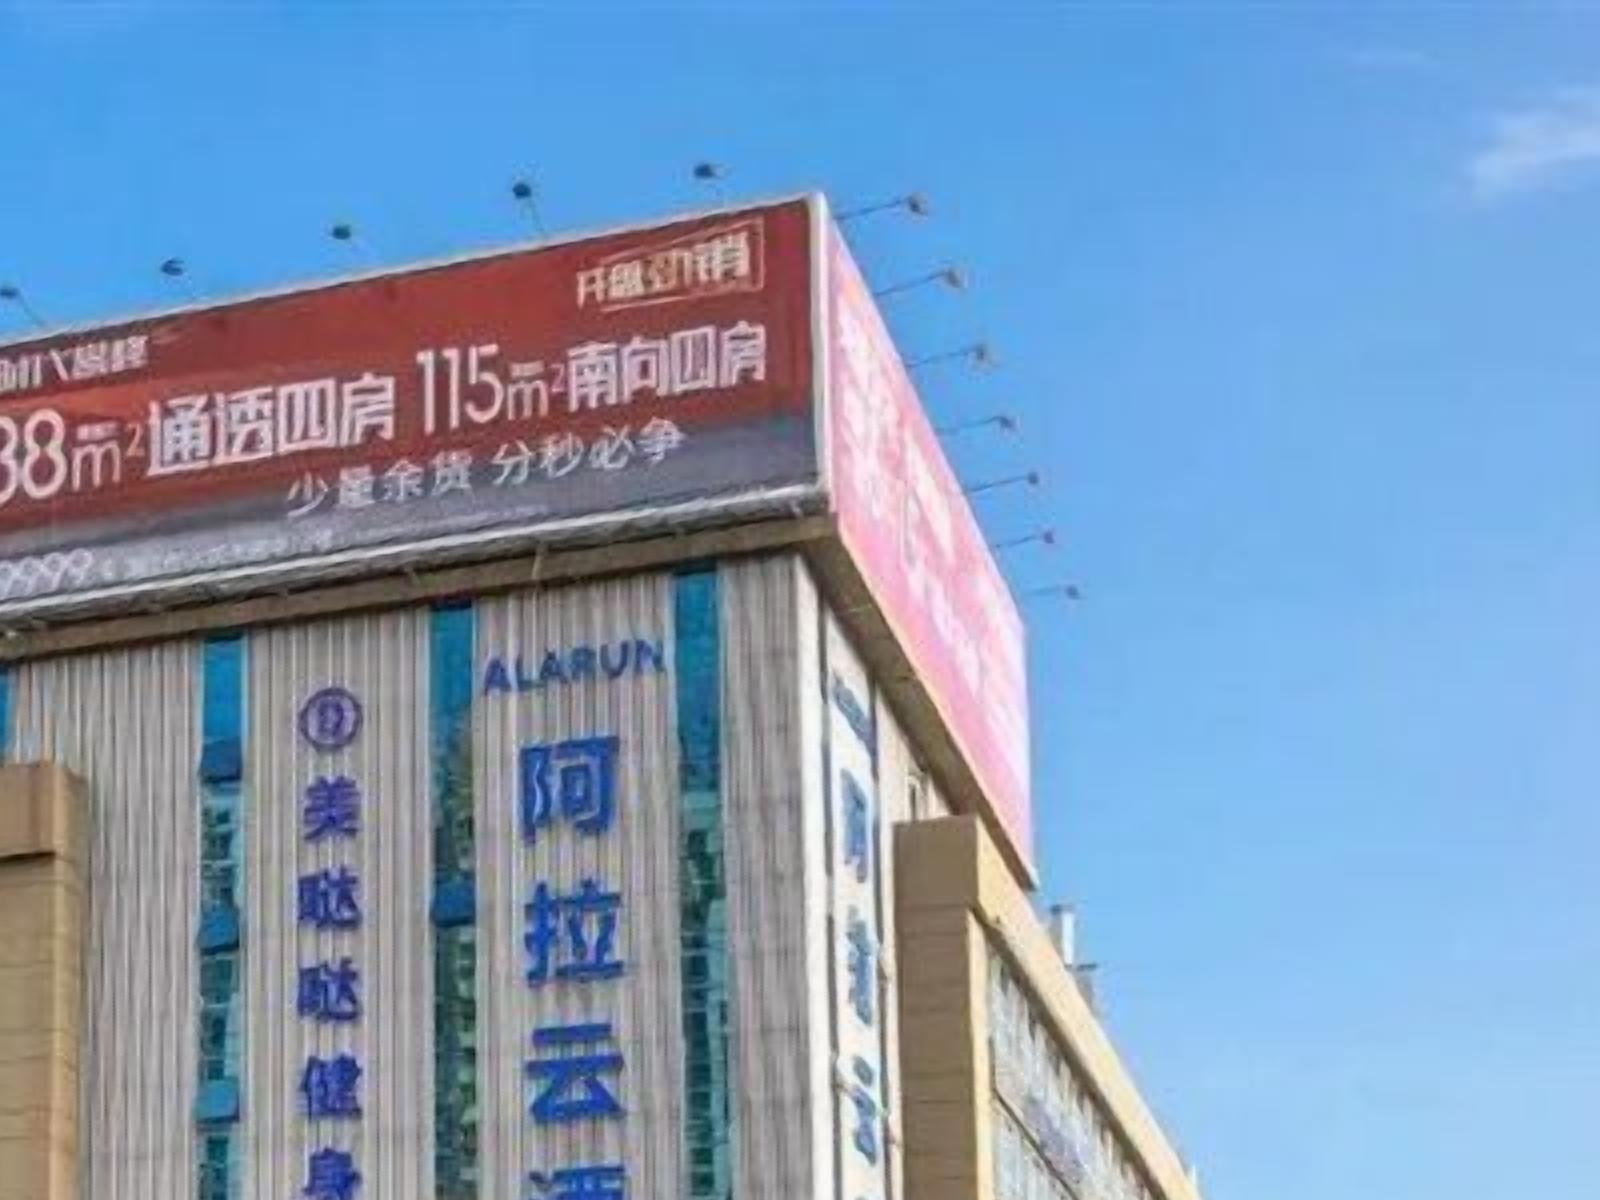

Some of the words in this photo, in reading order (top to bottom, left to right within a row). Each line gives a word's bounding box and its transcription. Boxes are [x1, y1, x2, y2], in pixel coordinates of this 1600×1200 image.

[492, 416, 686, 486] 分秒必争
[483, 638, 667, 695] ALARUN
